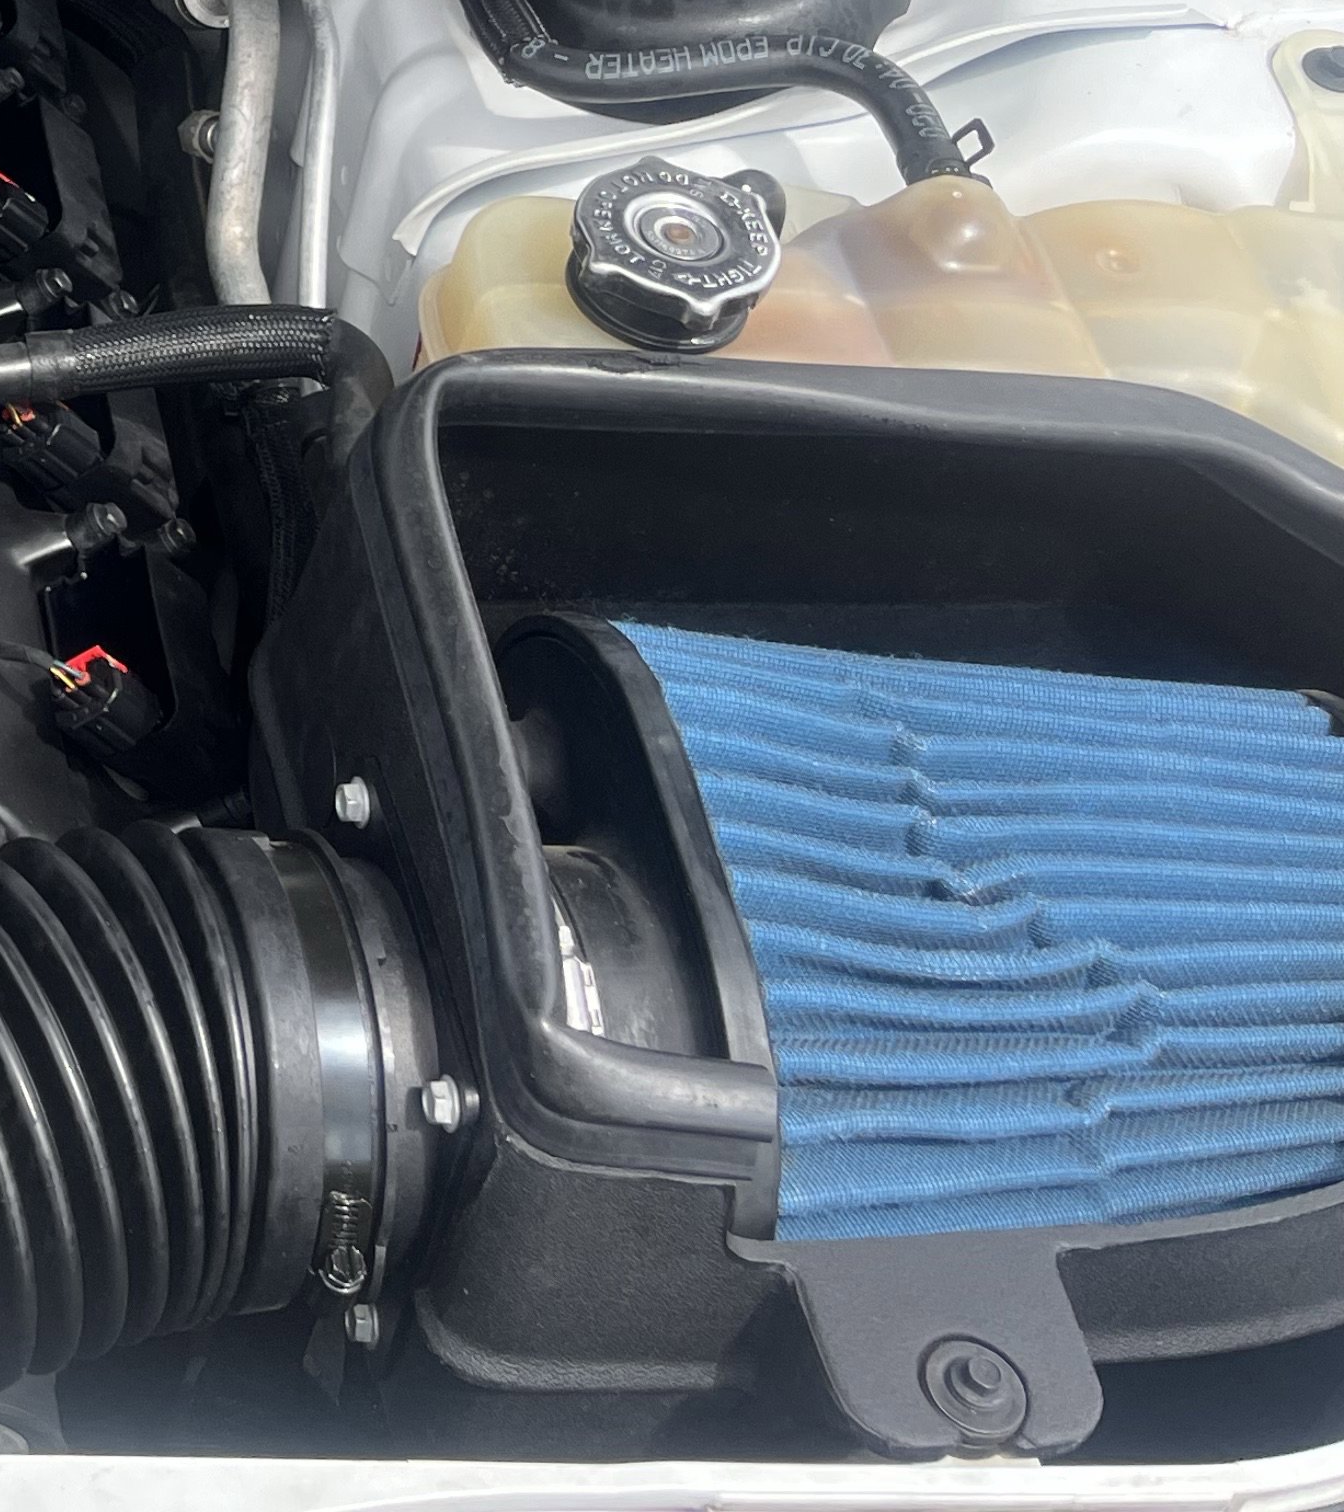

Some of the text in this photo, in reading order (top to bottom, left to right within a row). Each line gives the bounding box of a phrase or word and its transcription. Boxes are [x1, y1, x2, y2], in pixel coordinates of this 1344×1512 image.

[585, 45, 691, 80] HEATER
[700, 37, 769, 64] EPDM
[614, 171, 654, 193] NOT
[659, 170, 690, 186] DO
[702, 207, 769, 289] KEEP TIGHT
